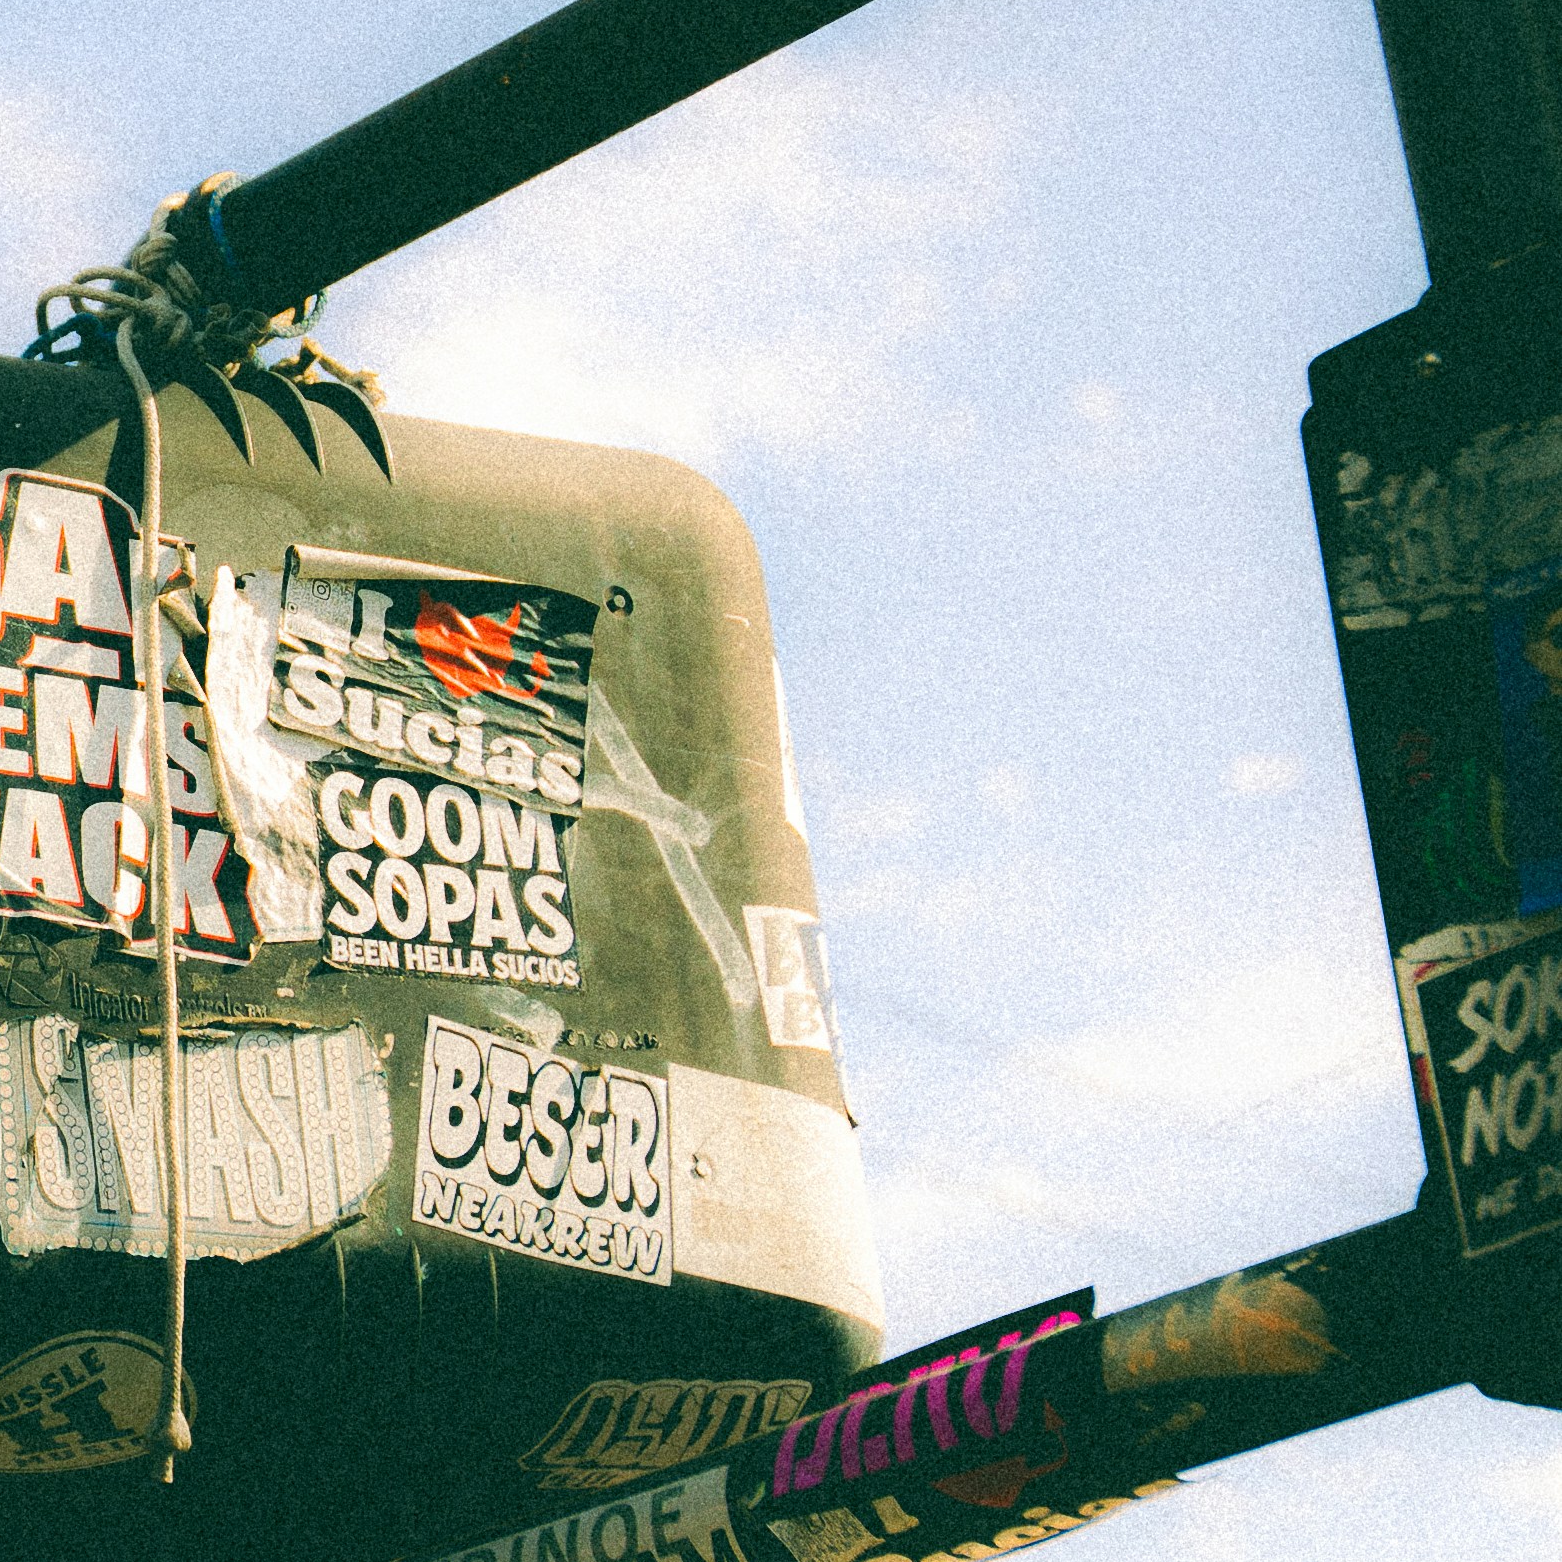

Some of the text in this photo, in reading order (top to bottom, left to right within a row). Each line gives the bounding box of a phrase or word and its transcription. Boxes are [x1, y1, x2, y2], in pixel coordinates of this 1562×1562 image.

[284, 654, 582, 806] Sucias
[327, 851, 575, 957] SOPAS
[331, 934, 581, 987] BEEN HELLA SUCIOS
[33, 1014, 360, 1227] SMASH
[429, 1025, 661, 1216] BESER
